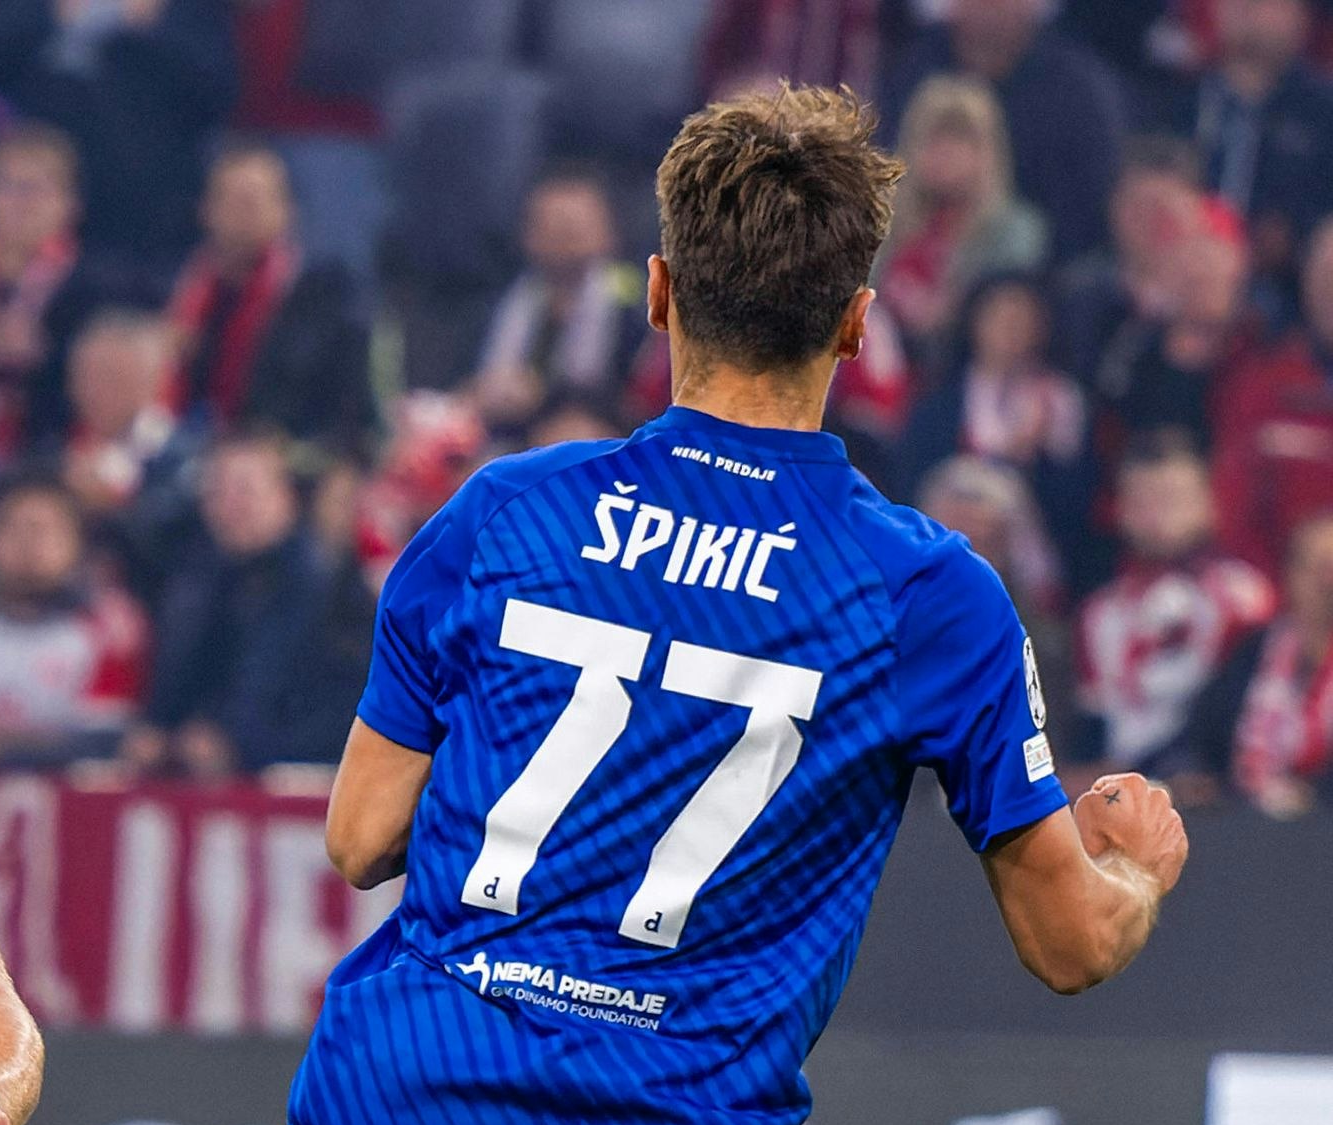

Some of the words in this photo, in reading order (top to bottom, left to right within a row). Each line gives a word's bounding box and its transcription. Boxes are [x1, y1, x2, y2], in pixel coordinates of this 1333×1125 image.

[671, 446, 711, 465] NEMA
[714, 456, 777, 482] PREDAJE
[580, 480, 798, 603] ŠPIKIĆ
[460, 598, 823, 949] 77
[491, 961, 555, 992] NEMA
[557, 975, 667, 1015] PREDAJE
[514, 987, 568, 1013] DINAMO
[569, 1003, 660, 1031] FOUNDATION
